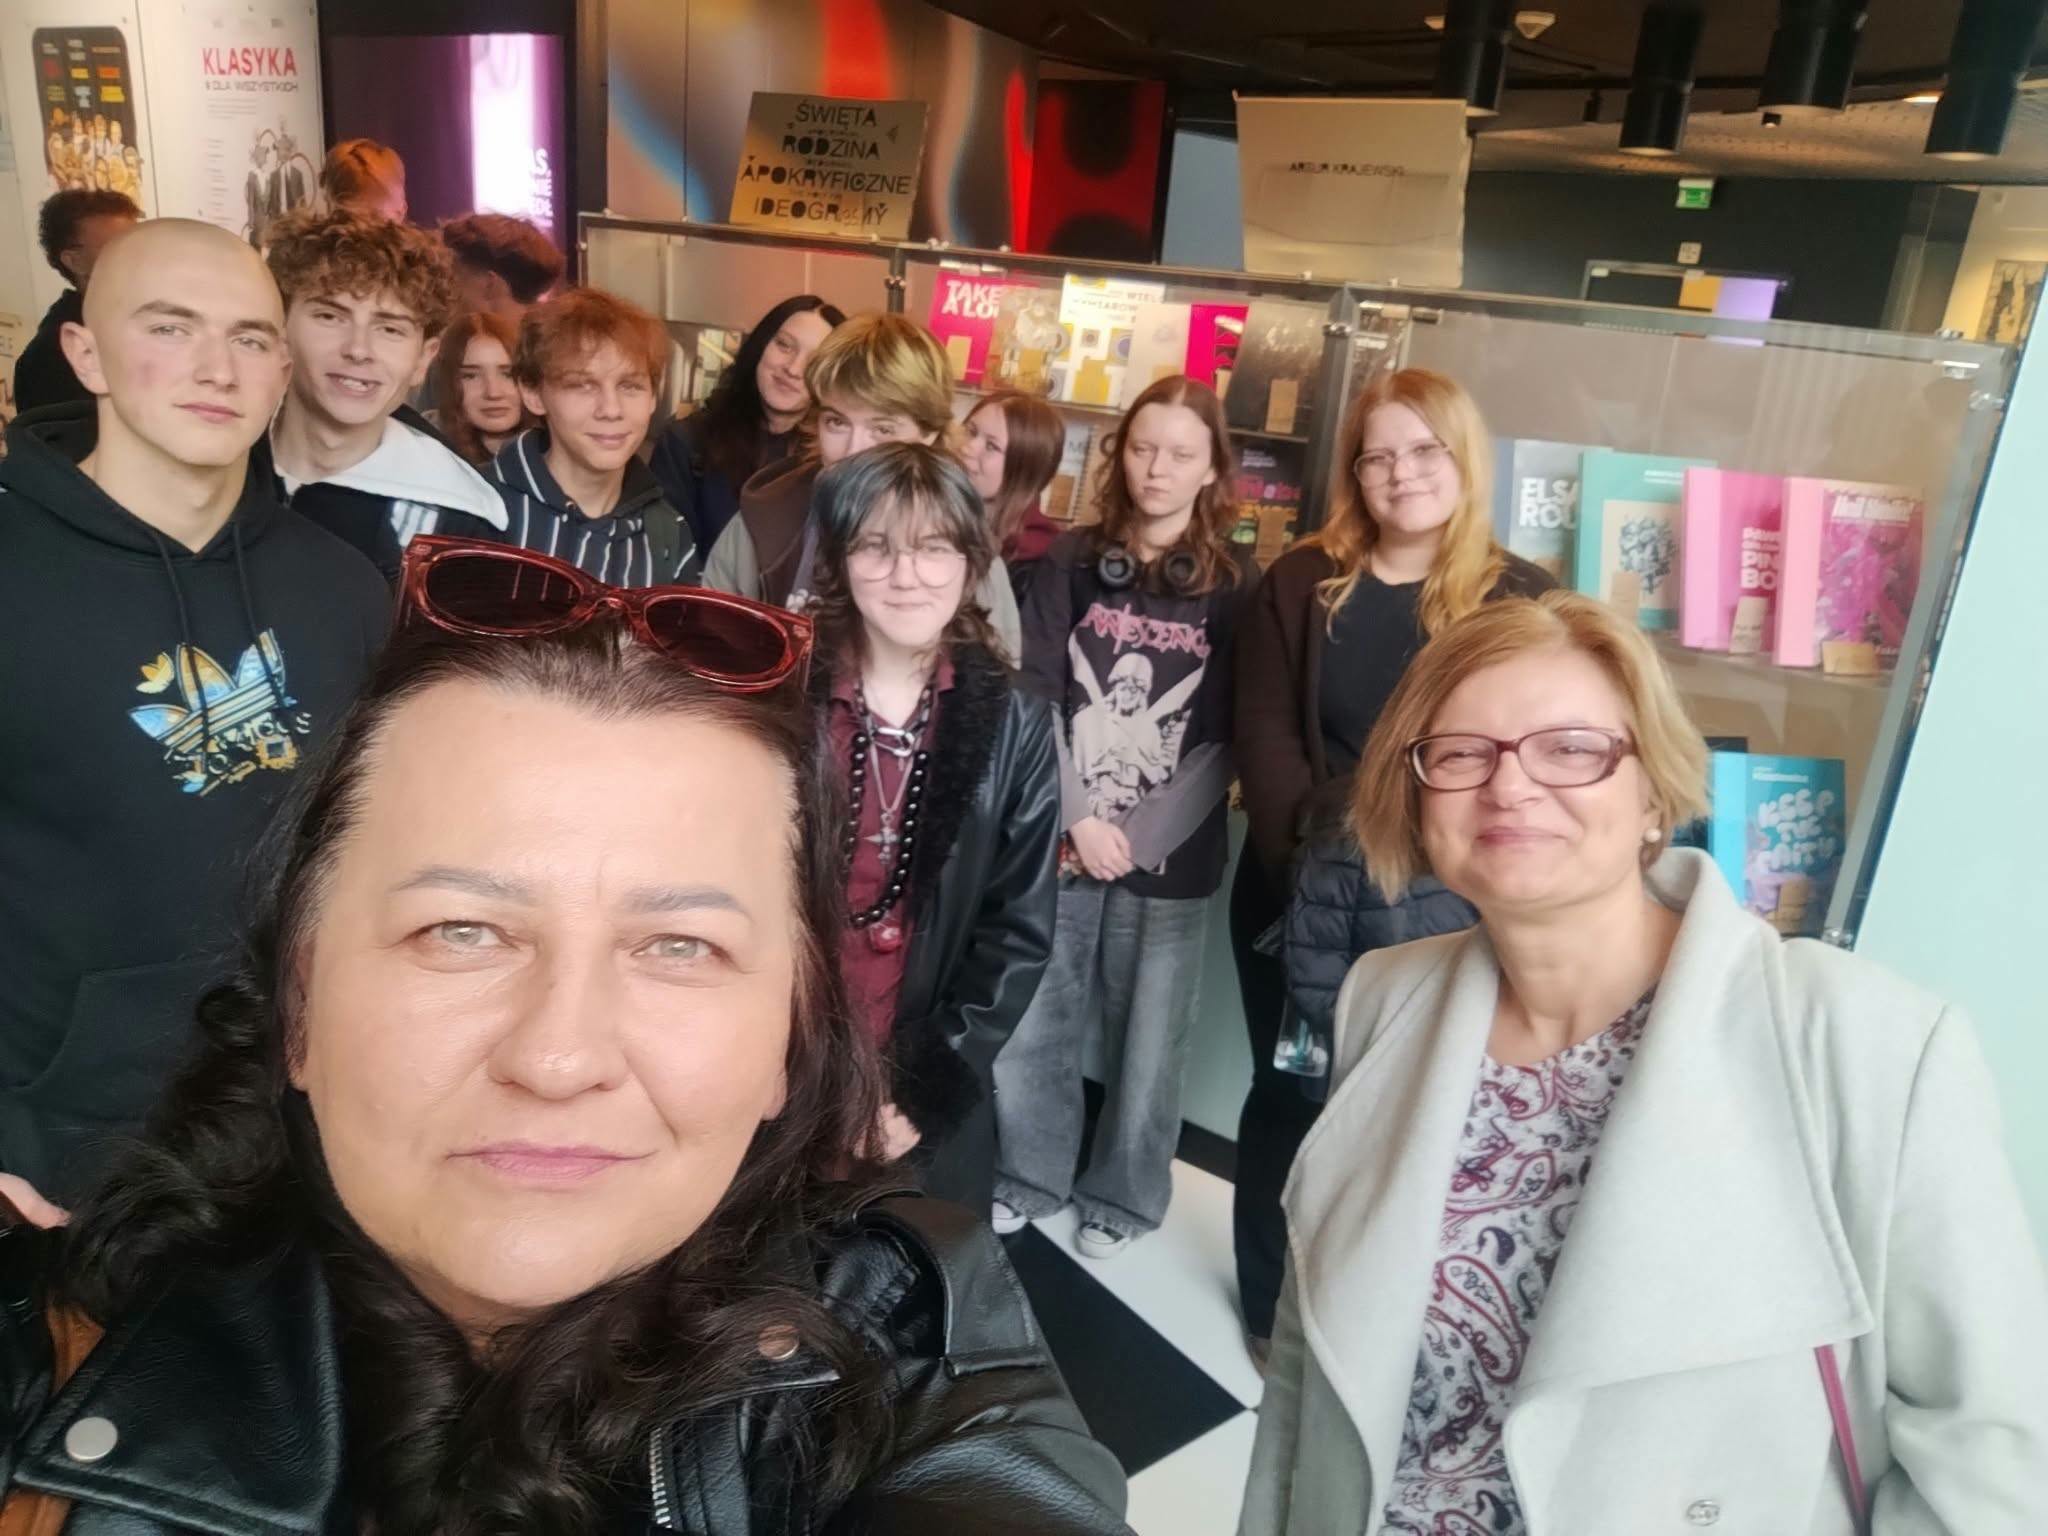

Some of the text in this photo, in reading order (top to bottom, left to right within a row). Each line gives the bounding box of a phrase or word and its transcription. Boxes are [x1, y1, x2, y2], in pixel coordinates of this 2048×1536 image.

[202, 46, 298, 76] KLASYKA
[782, 135, 880, 160] RODZINA
[741, 162, 912, 194] APOKRYFICZNE
[946, 279, 1003, 305] TAKE
